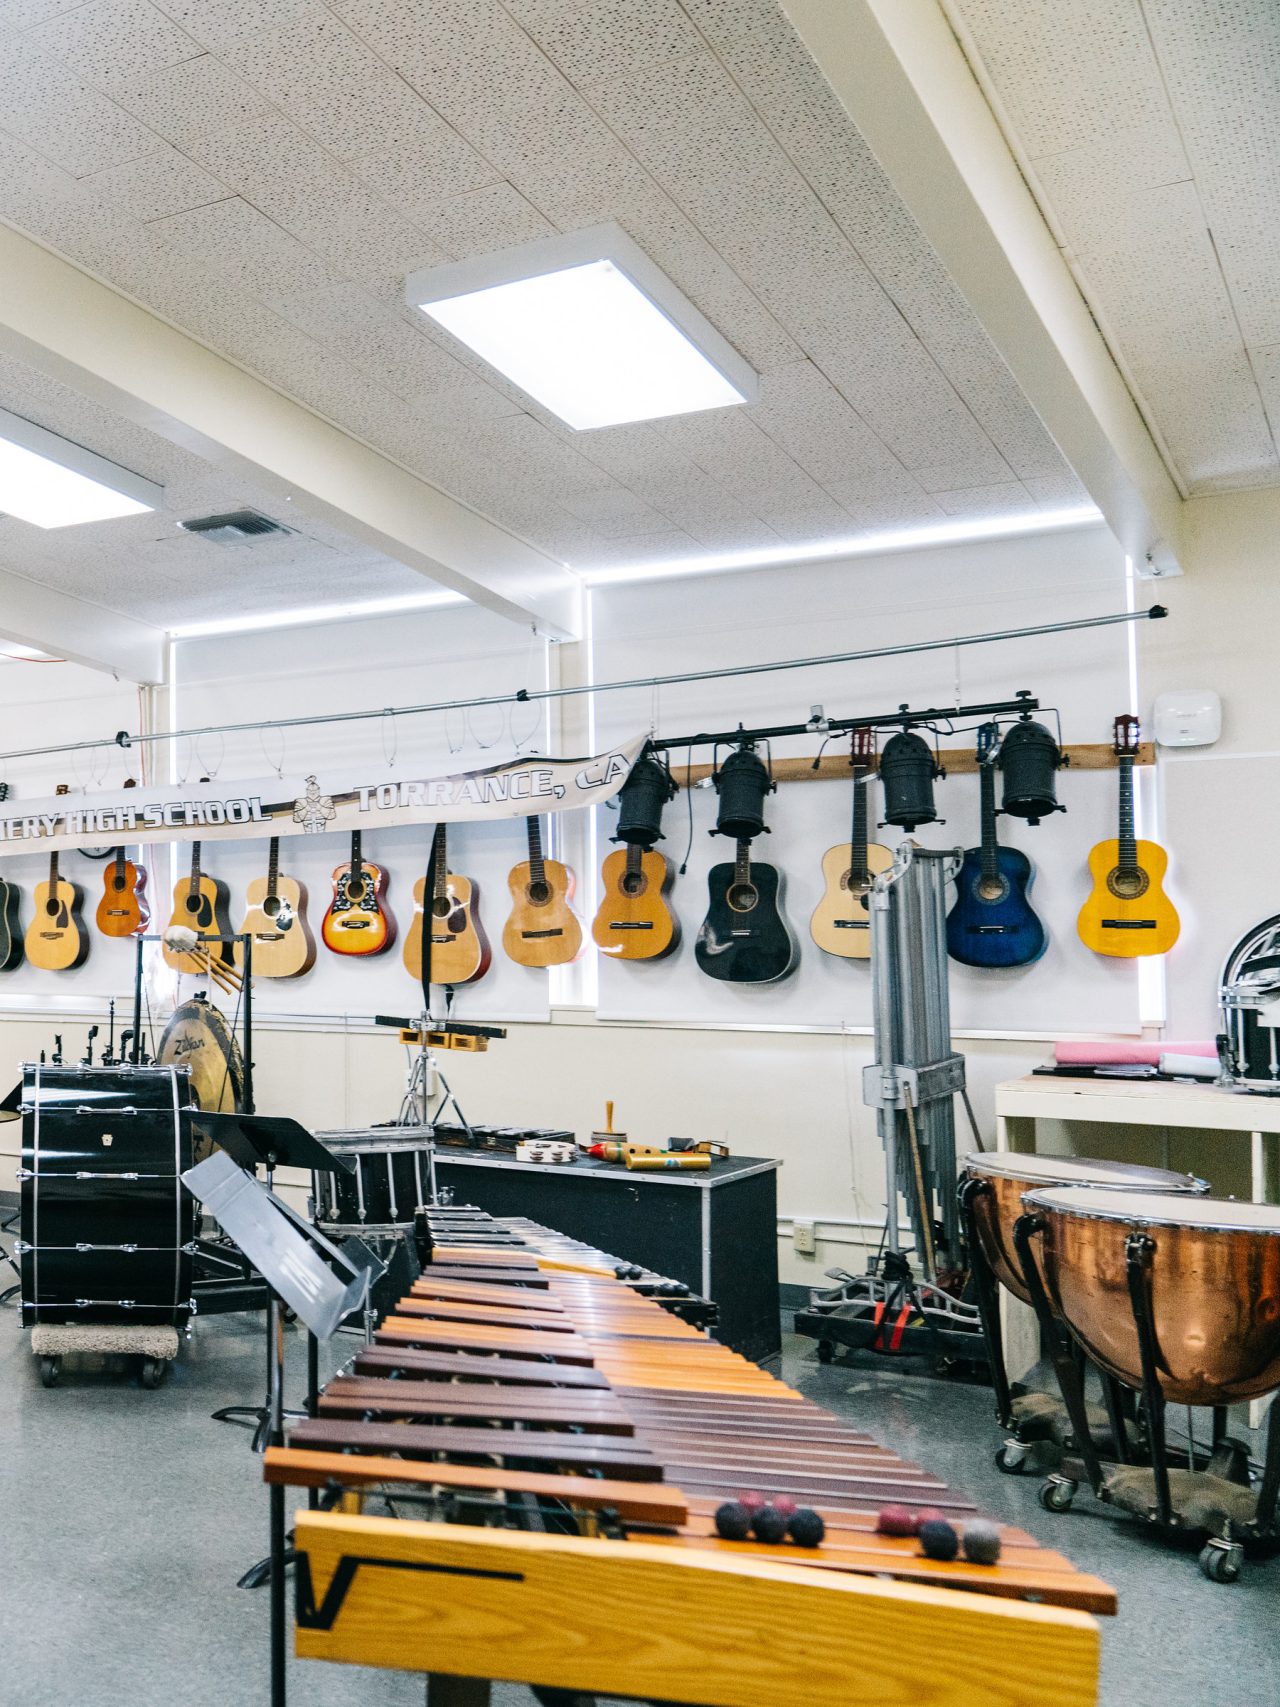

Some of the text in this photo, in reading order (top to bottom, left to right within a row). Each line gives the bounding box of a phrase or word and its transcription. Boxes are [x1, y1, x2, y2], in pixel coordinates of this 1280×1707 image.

[353, 753, 634, 813] TORRANCE, CA
[64, 805, 138, 835] HIGH
[142, 796, 273, 829] SCHOOL
